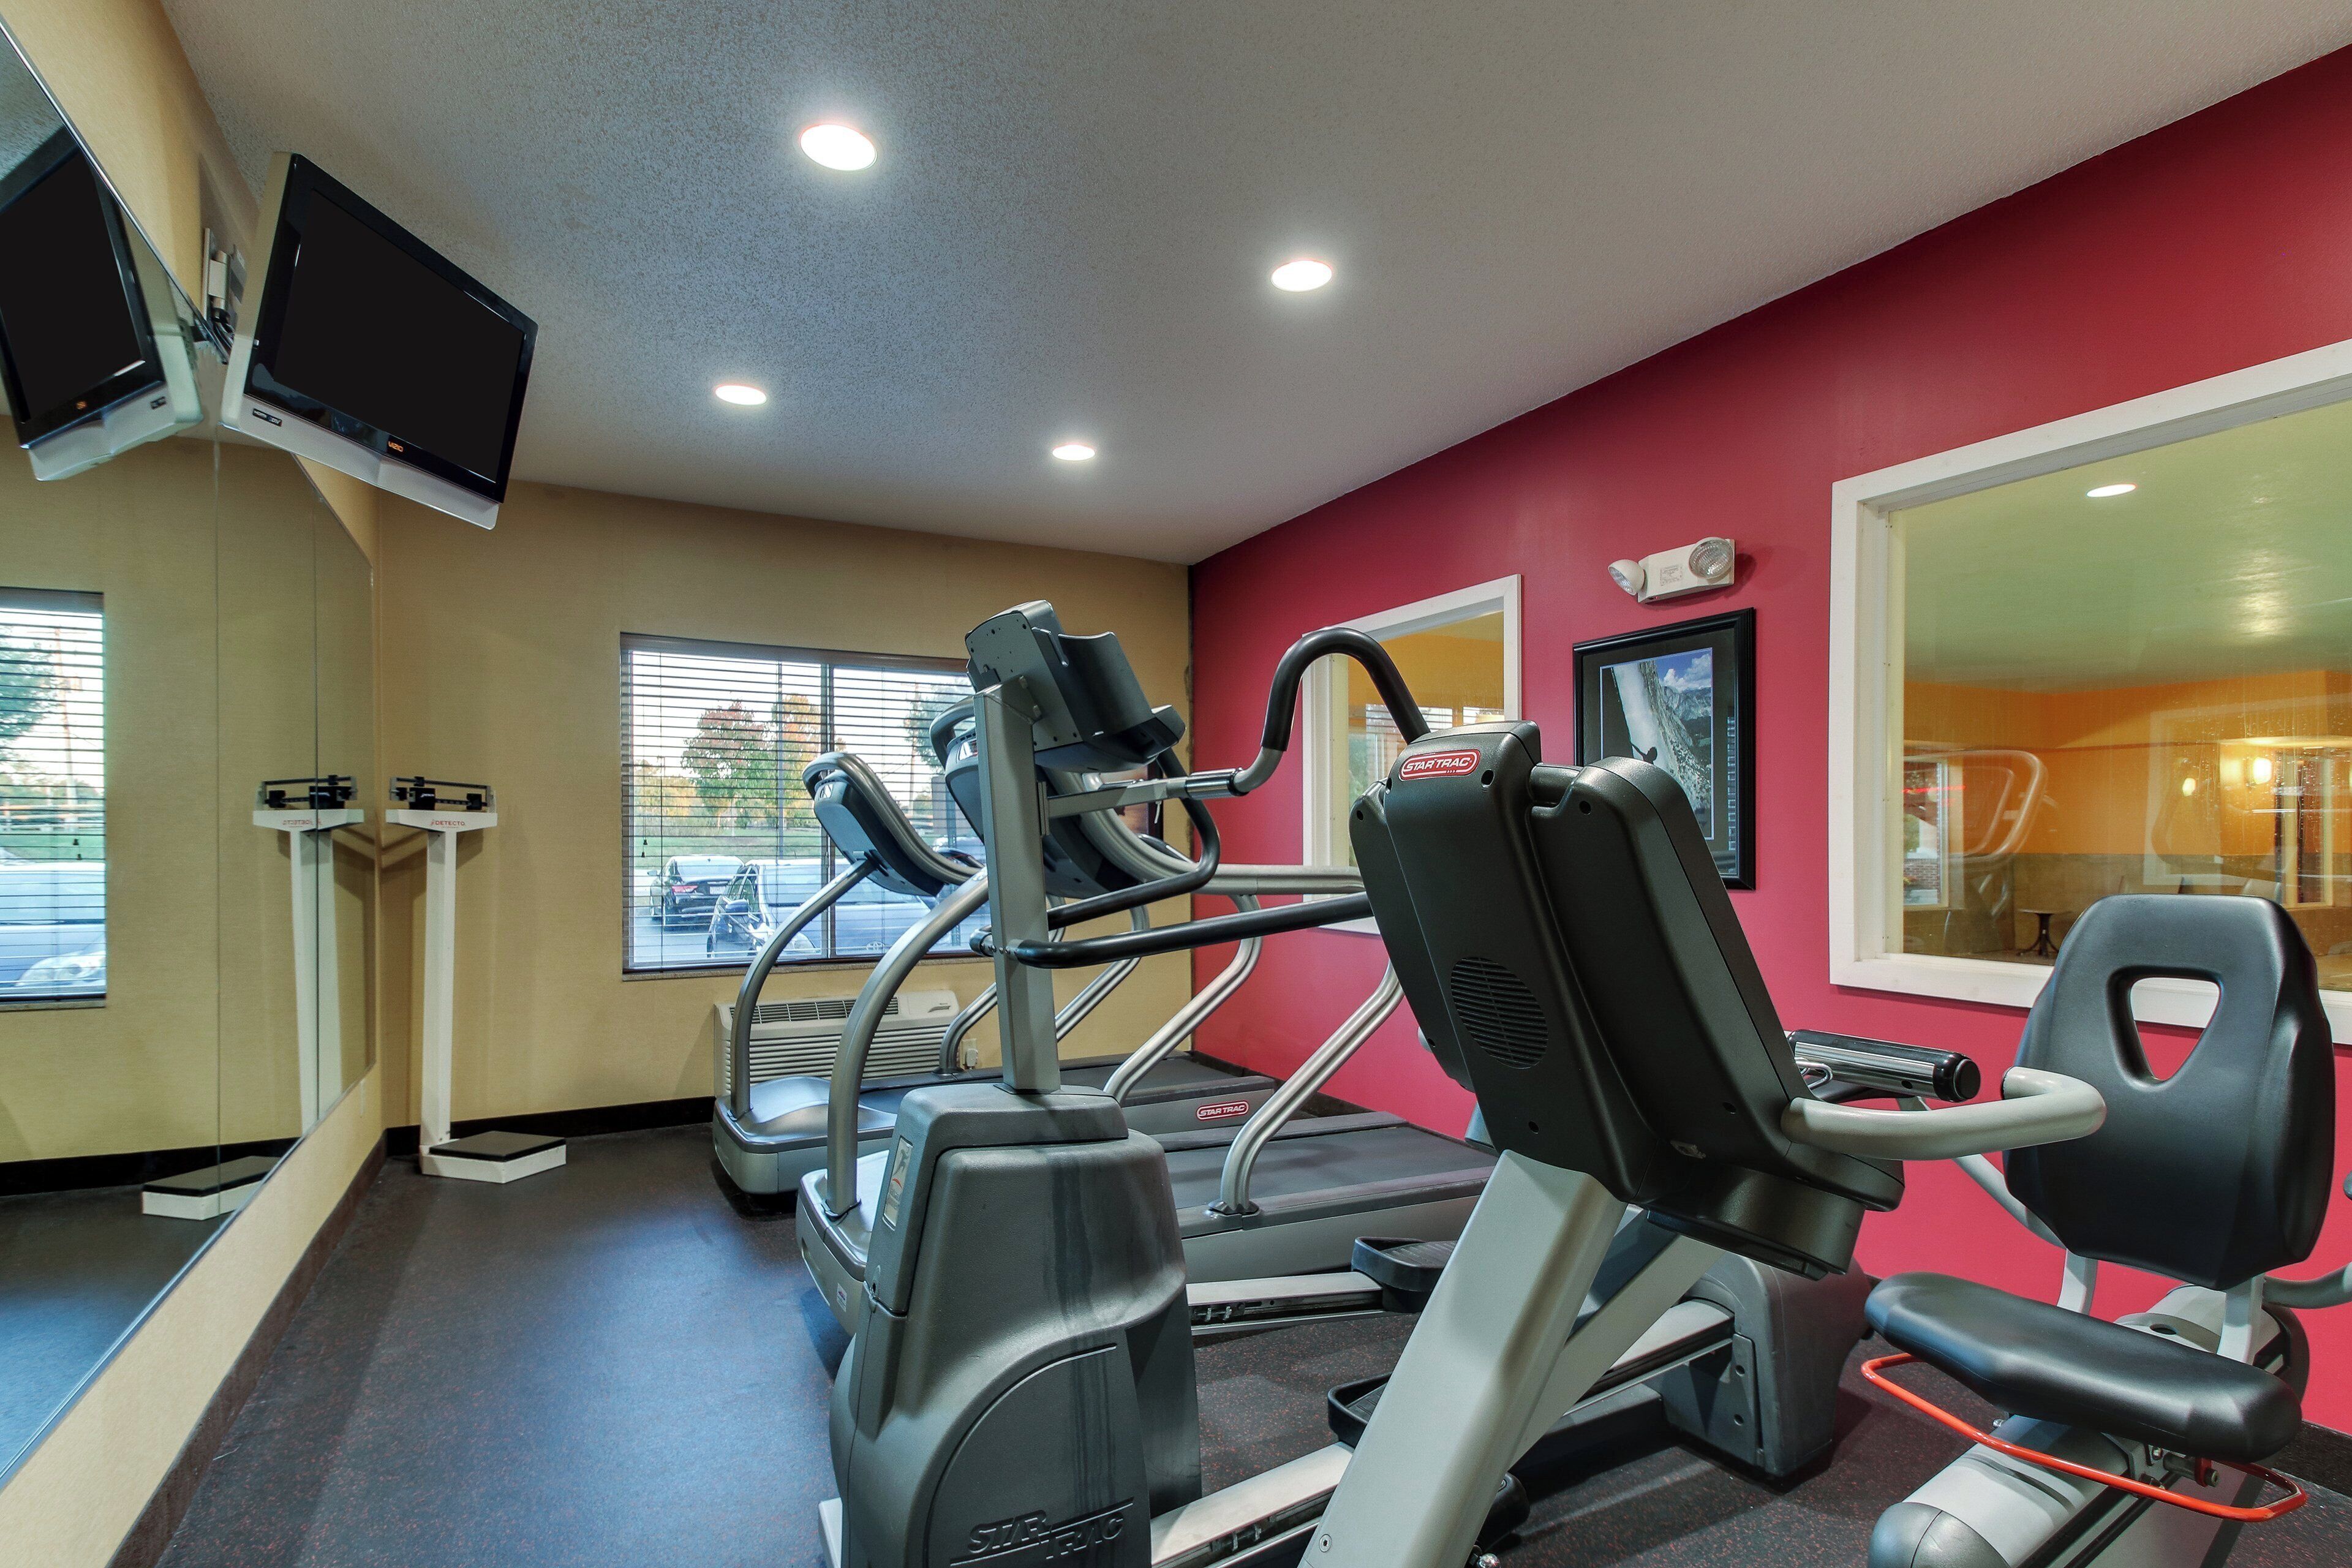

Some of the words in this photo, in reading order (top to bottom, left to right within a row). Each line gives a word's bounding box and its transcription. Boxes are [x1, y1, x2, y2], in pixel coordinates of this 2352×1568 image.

[1406, 760, 1434, 771] STAR
[1435, 757, 1471, 768] TRAC
[1200, 1108, 1222, 1117] STAR
[1222, 1104, 1245, 1113] TRAC
[968, 1510, 1048, 1553] STAR
[1040, 1512, 1123, 1560] TRAC
